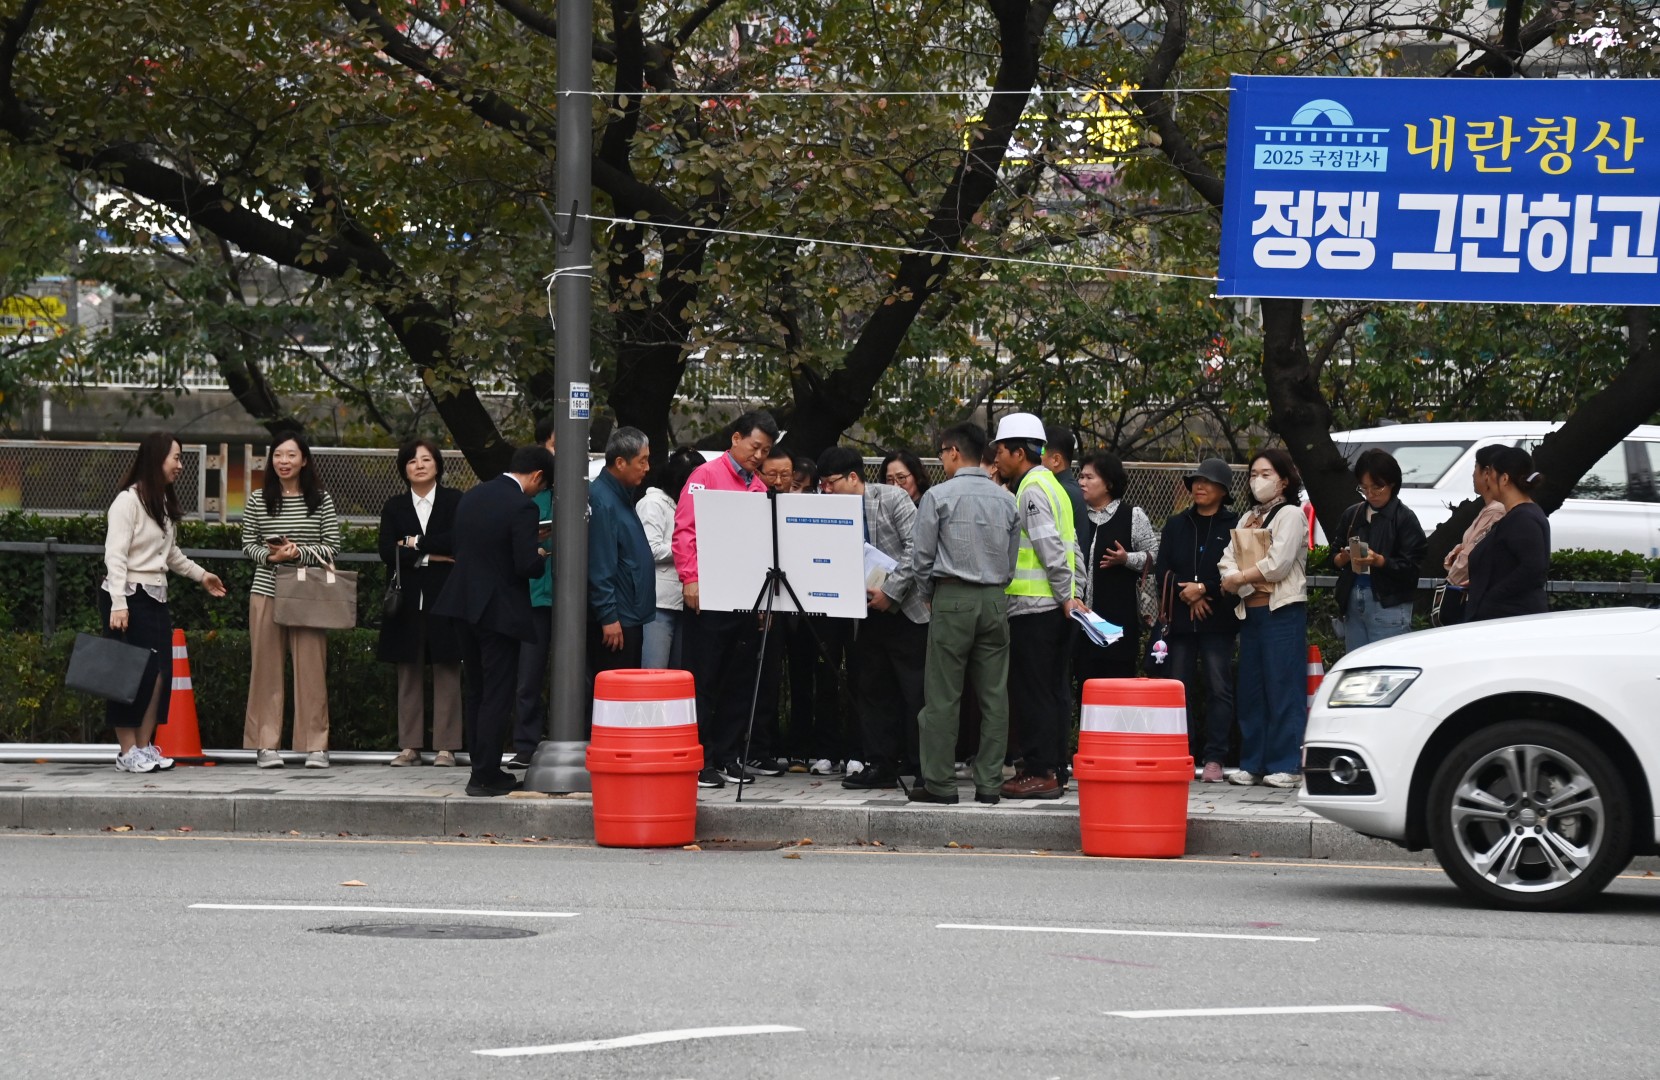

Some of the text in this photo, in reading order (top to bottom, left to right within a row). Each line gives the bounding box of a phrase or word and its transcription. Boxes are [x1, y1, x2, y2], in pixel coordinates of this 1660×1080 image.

[1261, 149, 1381, 168] 2025 국정감사
[1404, 115, 1644, 175] 내란청산
[1251, 190, 1660, 274] 정쟁 그만하고
